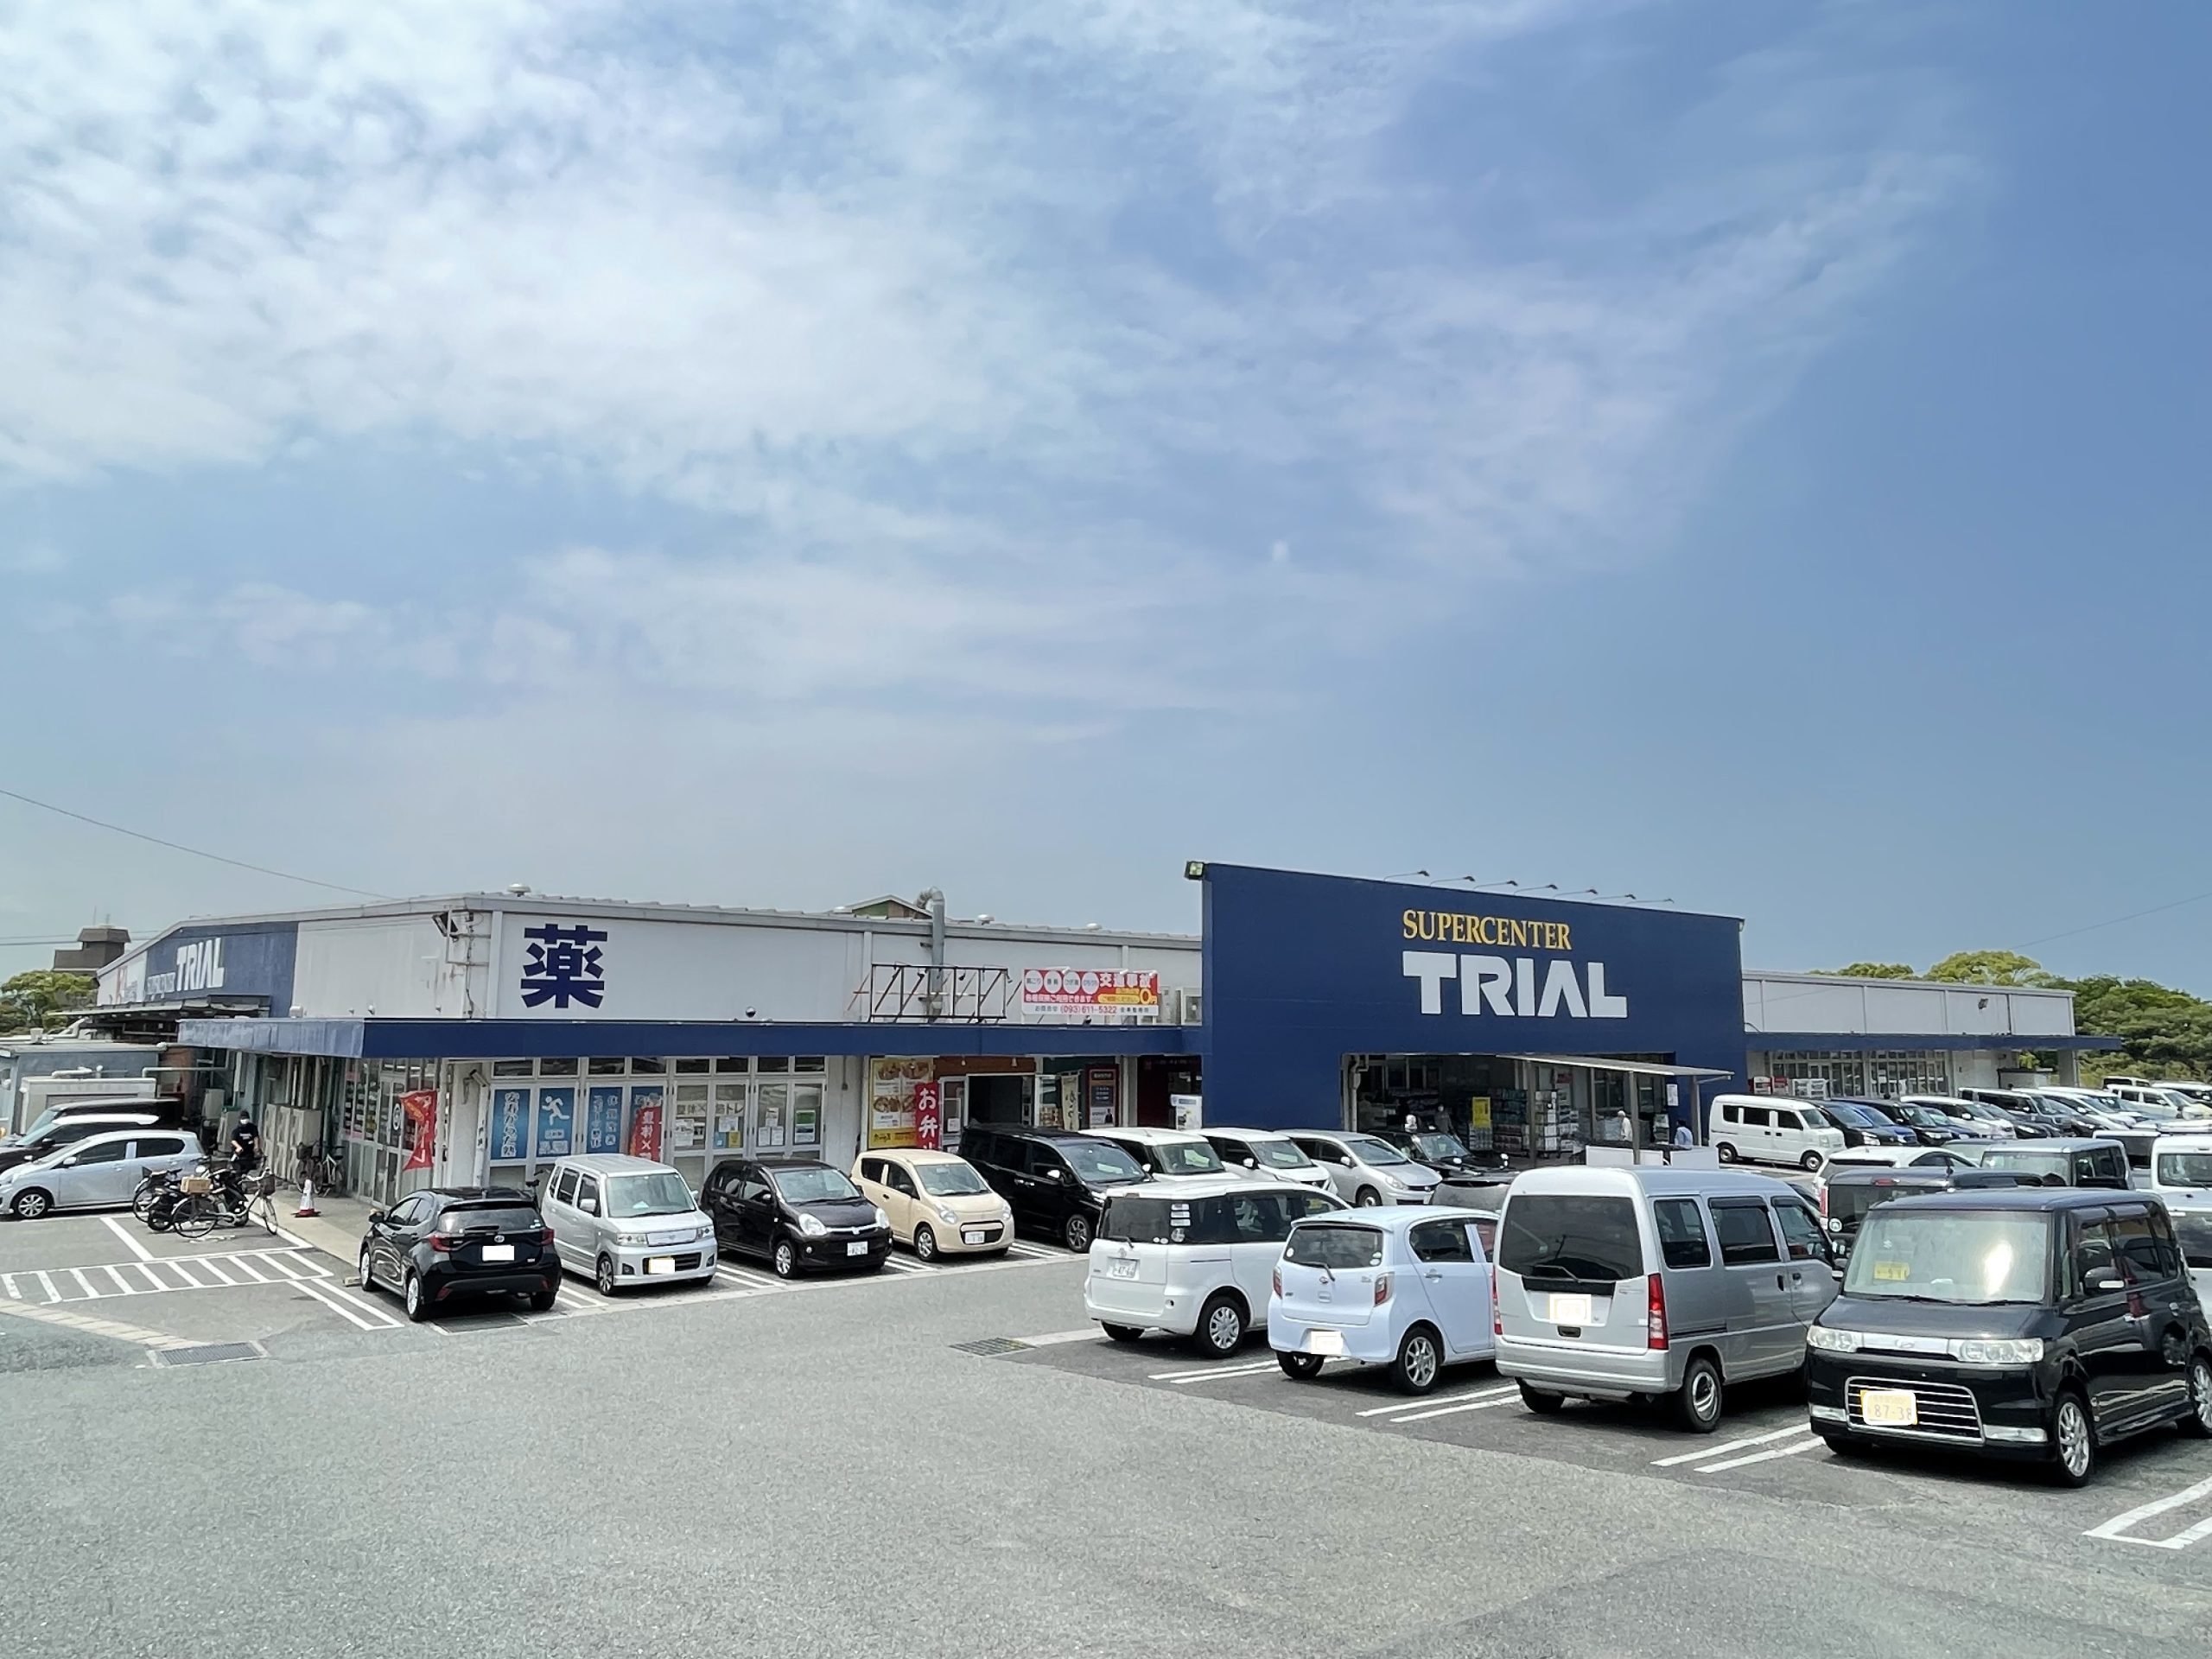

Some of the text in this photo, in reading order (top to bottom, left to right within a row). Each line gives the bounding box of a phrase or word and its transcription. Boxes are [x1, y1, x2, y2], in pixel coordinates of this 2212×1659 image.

[1402, 909, 1573, 950] SUPERCENTER
[175, 937, 226, 992] TRIAL
[520, 924, 608, 1008] 薬
[1402, 950, 1628, 1018] TRIAL
